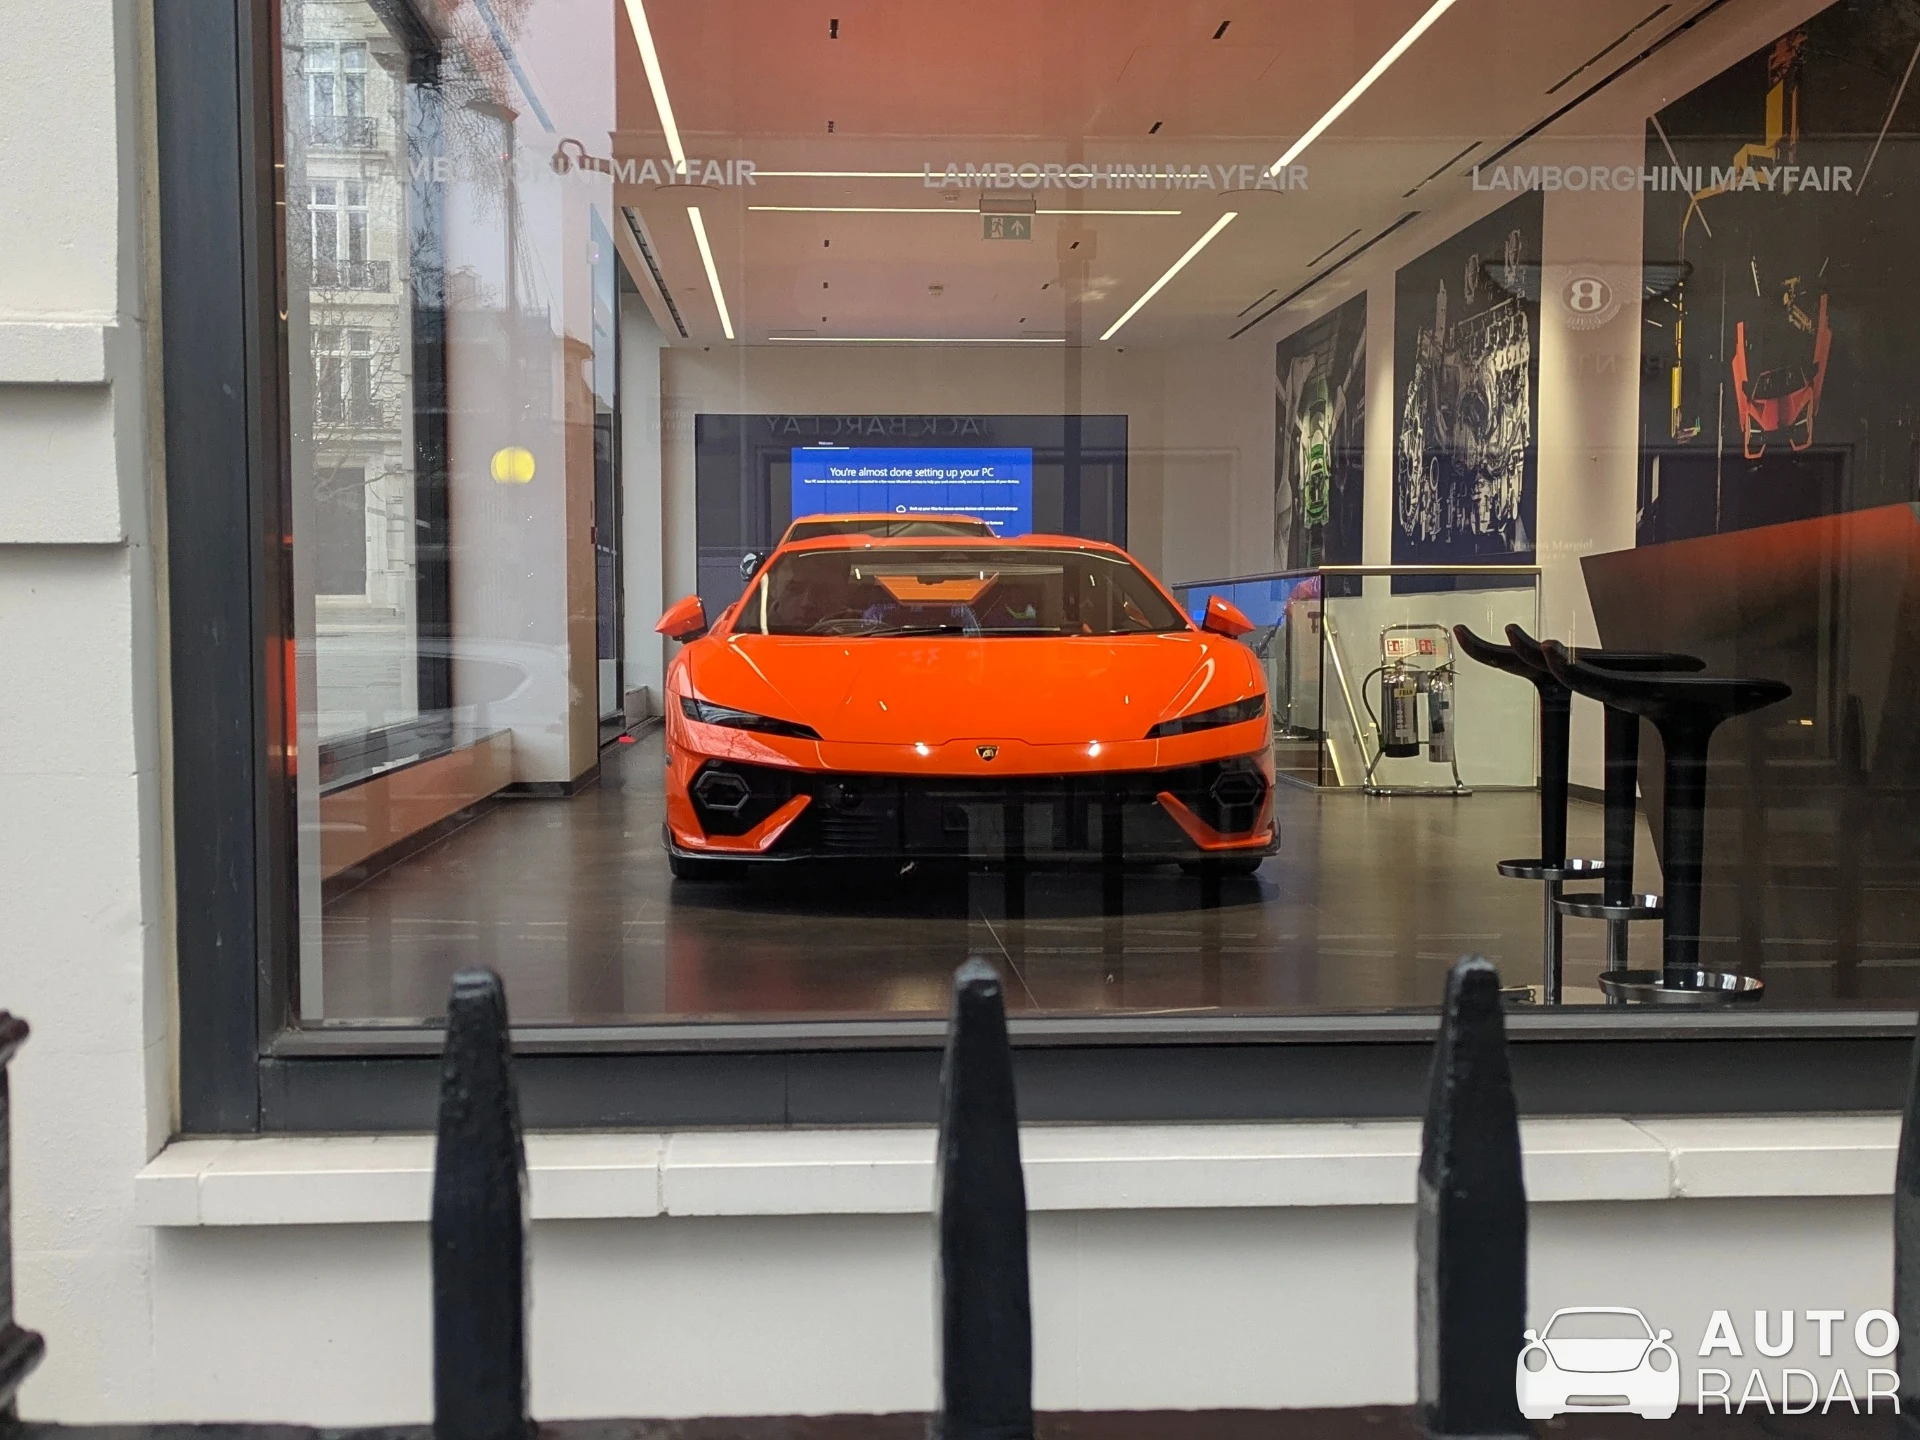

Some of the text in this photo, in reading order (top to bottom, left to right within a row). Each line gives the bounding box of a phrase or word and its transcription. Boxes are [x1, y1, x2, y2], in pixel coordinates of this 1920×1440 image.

[362, 156, 757, 187] AMBOGHINI MAYFAIR
[923, 162, 1309, 191] LAMBORGHINI MAYFAIR
[1472, 165, 1854, 192] LAMBORGHINI MAYFAIR
[830, 467, 995, 480] You're almost done setting up your PC
